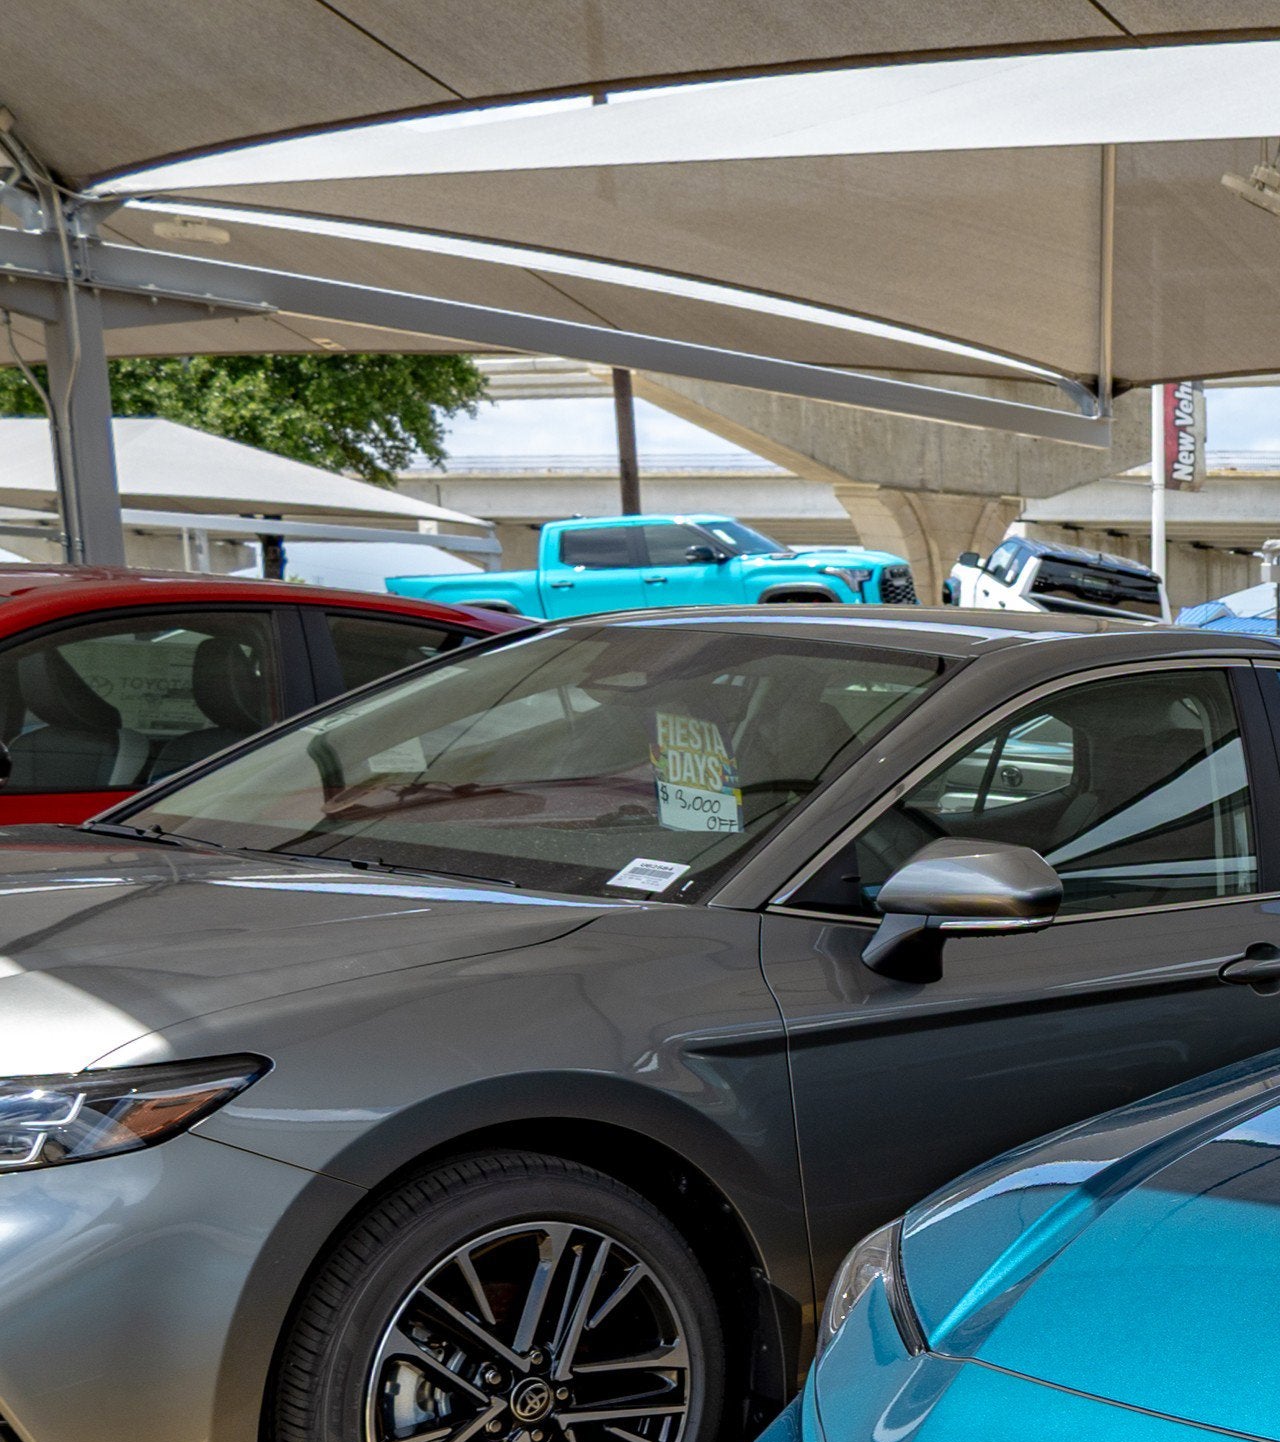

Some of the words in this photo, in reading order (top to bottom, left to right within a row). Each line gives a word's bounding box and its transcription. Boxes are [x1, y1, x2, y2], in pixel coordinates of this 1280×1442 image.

[1172, 430, 1195, 481] New
[656, 711, 728, 759] FIESTA
[668, 749, 723, 791] DAYS
[660, 784, 669, 804] $
[675, 789, 721, 813] 3,000
[706, 816, 738, 832] OFF
